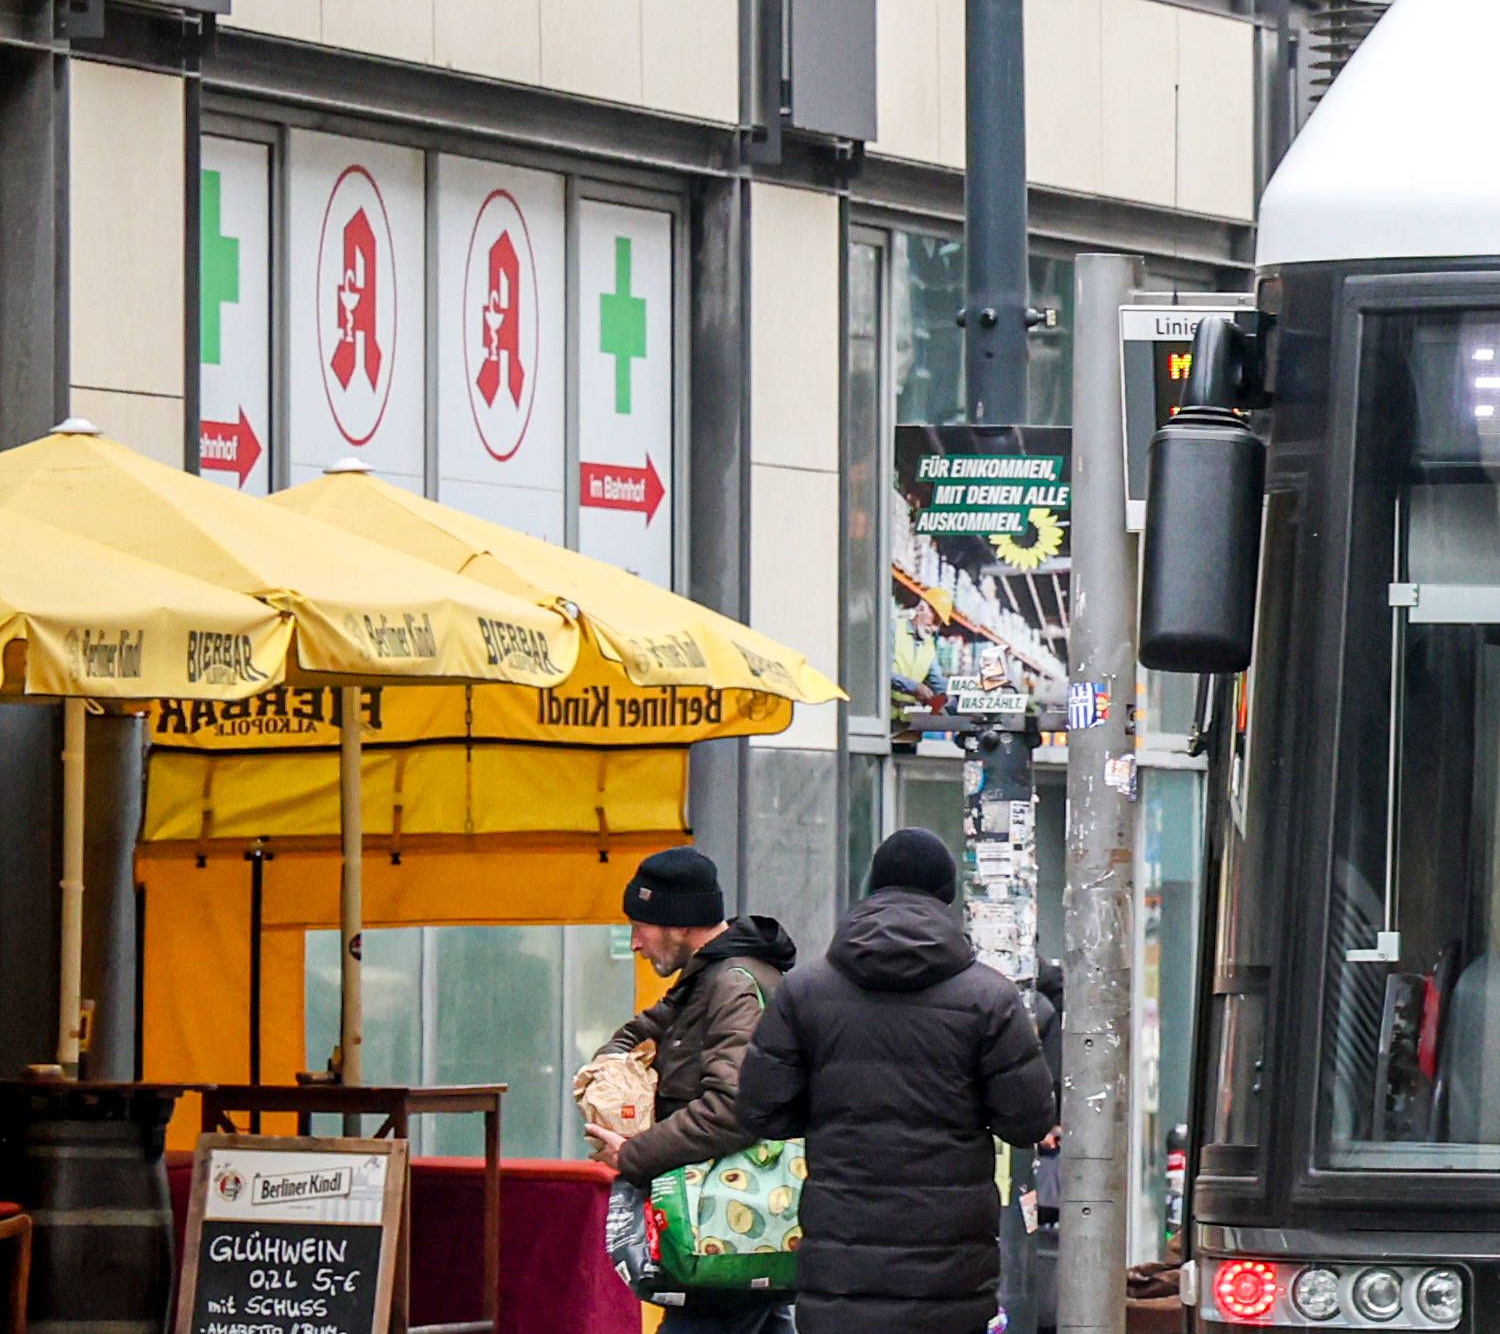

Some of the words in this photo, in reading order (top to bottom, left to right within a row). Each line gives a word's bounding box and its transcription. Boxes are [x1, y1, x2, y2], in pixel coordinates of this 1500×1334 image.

[1156, 318, 1198, 335] Linie
[200, 432, 238, 461] ahnhof
[919, 455, 951, 478] FÜR
[950, 459, 1057, 481] EINKOMMEN,
[604, 475, 645, 503] Bahnhof
[935, 485, 966, 505] MIT
[966, 486, 1024, 505] DENEN
[1024, 487, 1070, 506] ALLE
[917, 511, 1024, 532] AUSKOMMEN.
[187, 630, 269, 682] BIERBAR
[477, 616, 564, 676] BIERBAR
[961, 696, 985, 709] WAS
[260, 1175, 307, 1200] Berliner
[309, 1171, 342, 1194] Kindl
[209, 1231, 347, 1264] GLÜHWEIN
[312, 1269, 360, 1296] 5,-€
[208, 1296, 236, 1315] mit
[244, 1296, 328, 1317] SCHUSS
